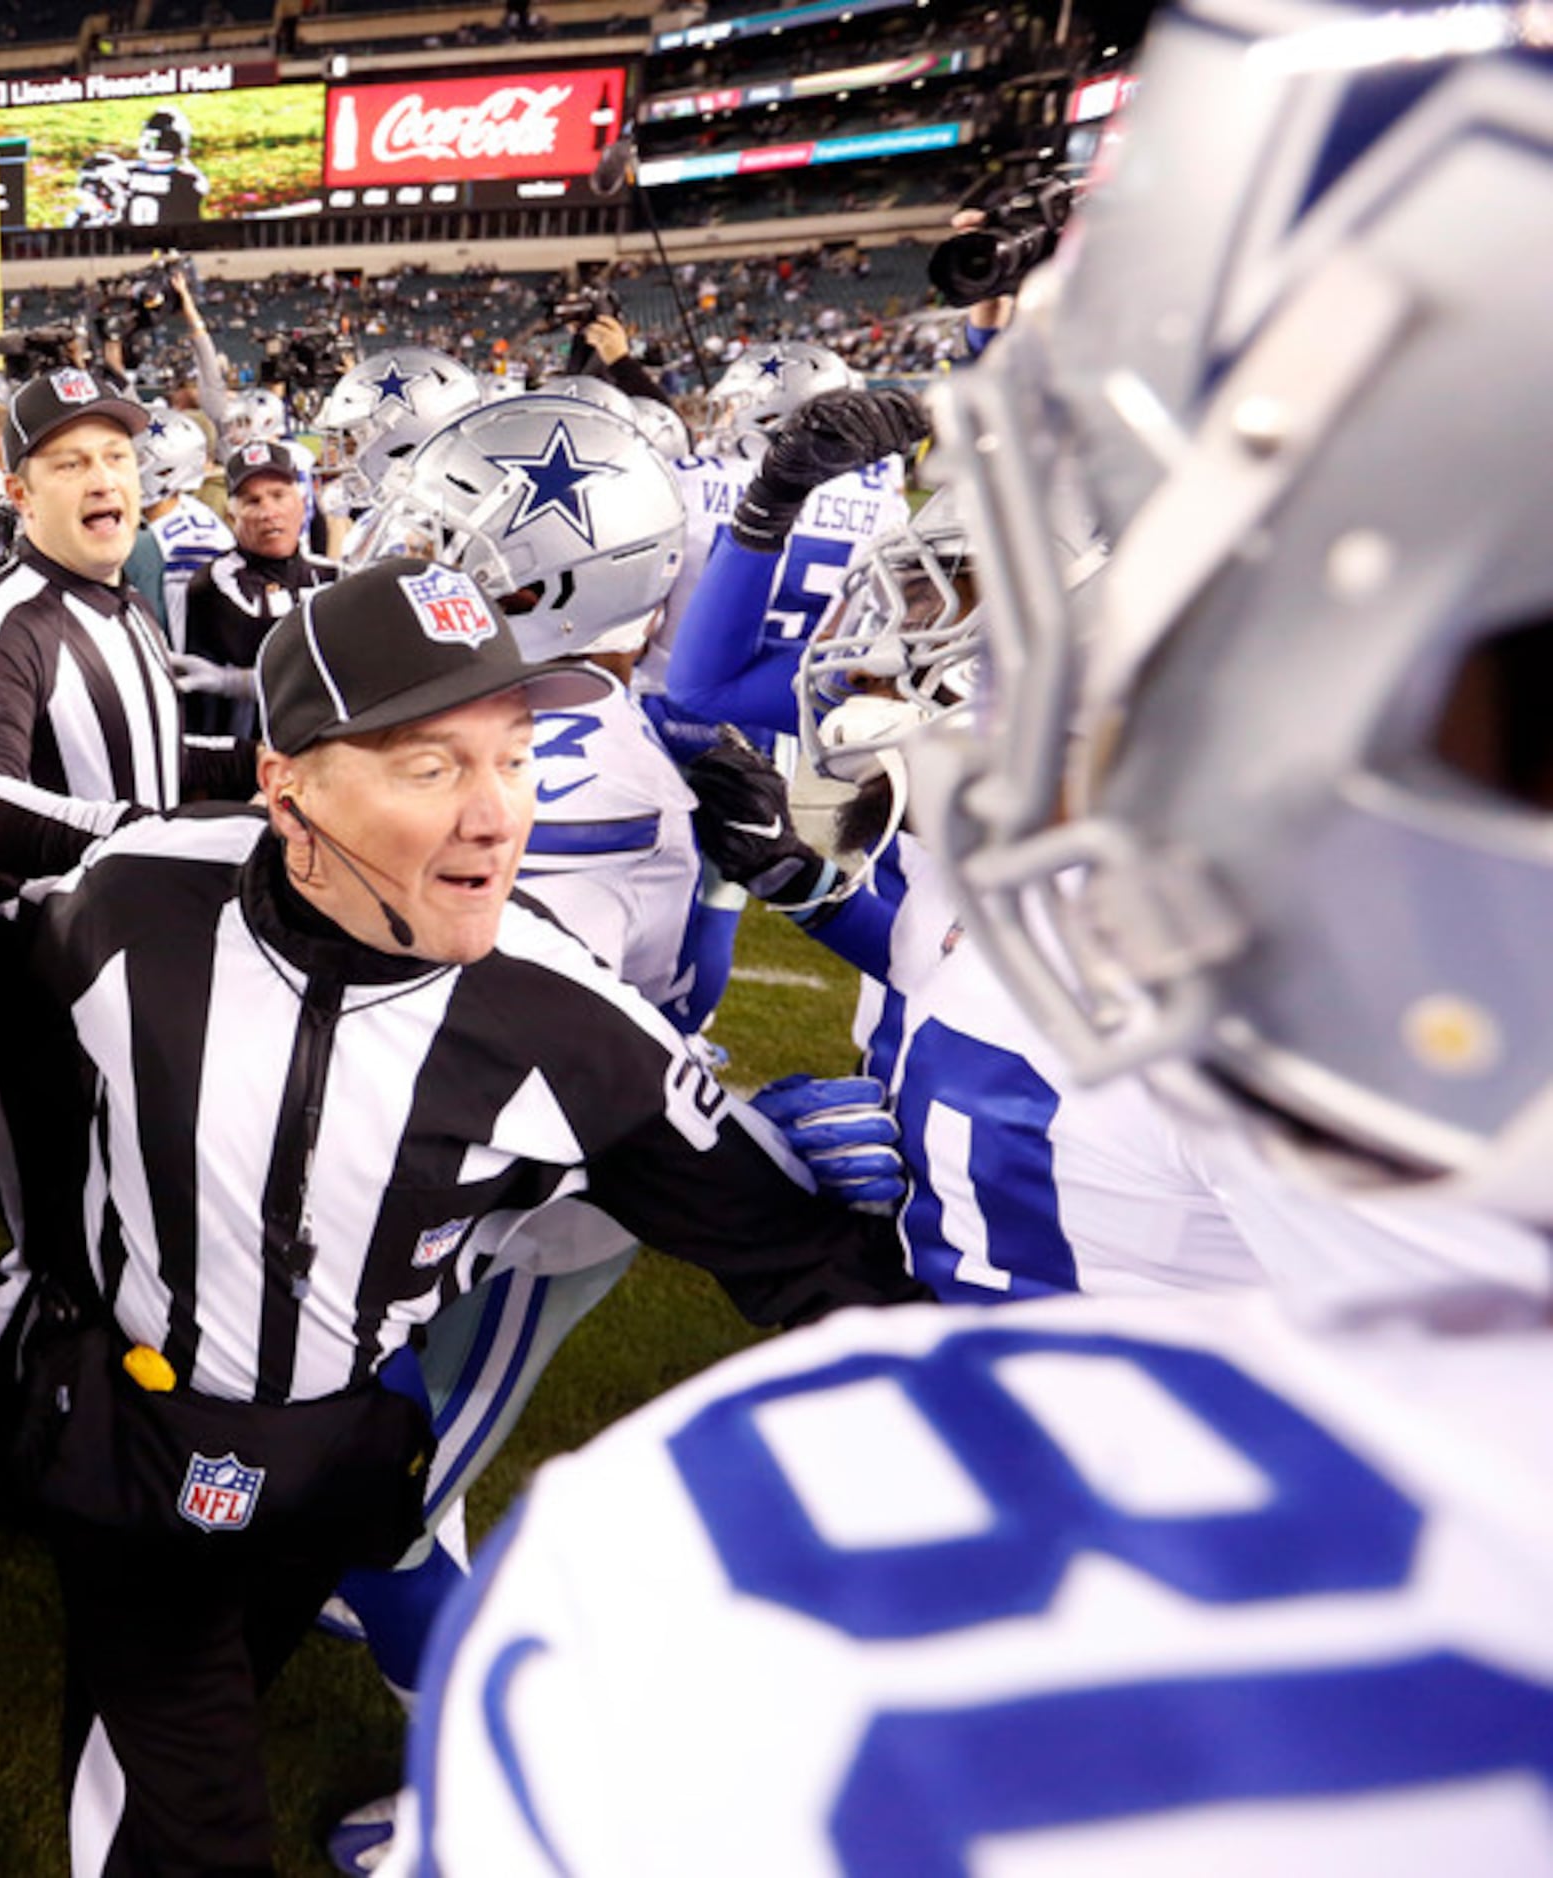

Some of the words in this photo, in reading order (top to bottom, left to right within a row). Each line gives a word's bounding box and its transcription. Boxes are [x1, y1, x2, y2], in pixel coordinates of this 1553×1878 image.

[12, 77, 83, 103] Lincoln
[86, 66, 177, 97] Financial
[180, 64, 233, 91] Field
[371, 84, 573, 163] Coca-Cola
[812, 493, 881, 535] ESCH
[424, 597, 492, 636] NFL
[187, 1484, 244, 1523] NFL
